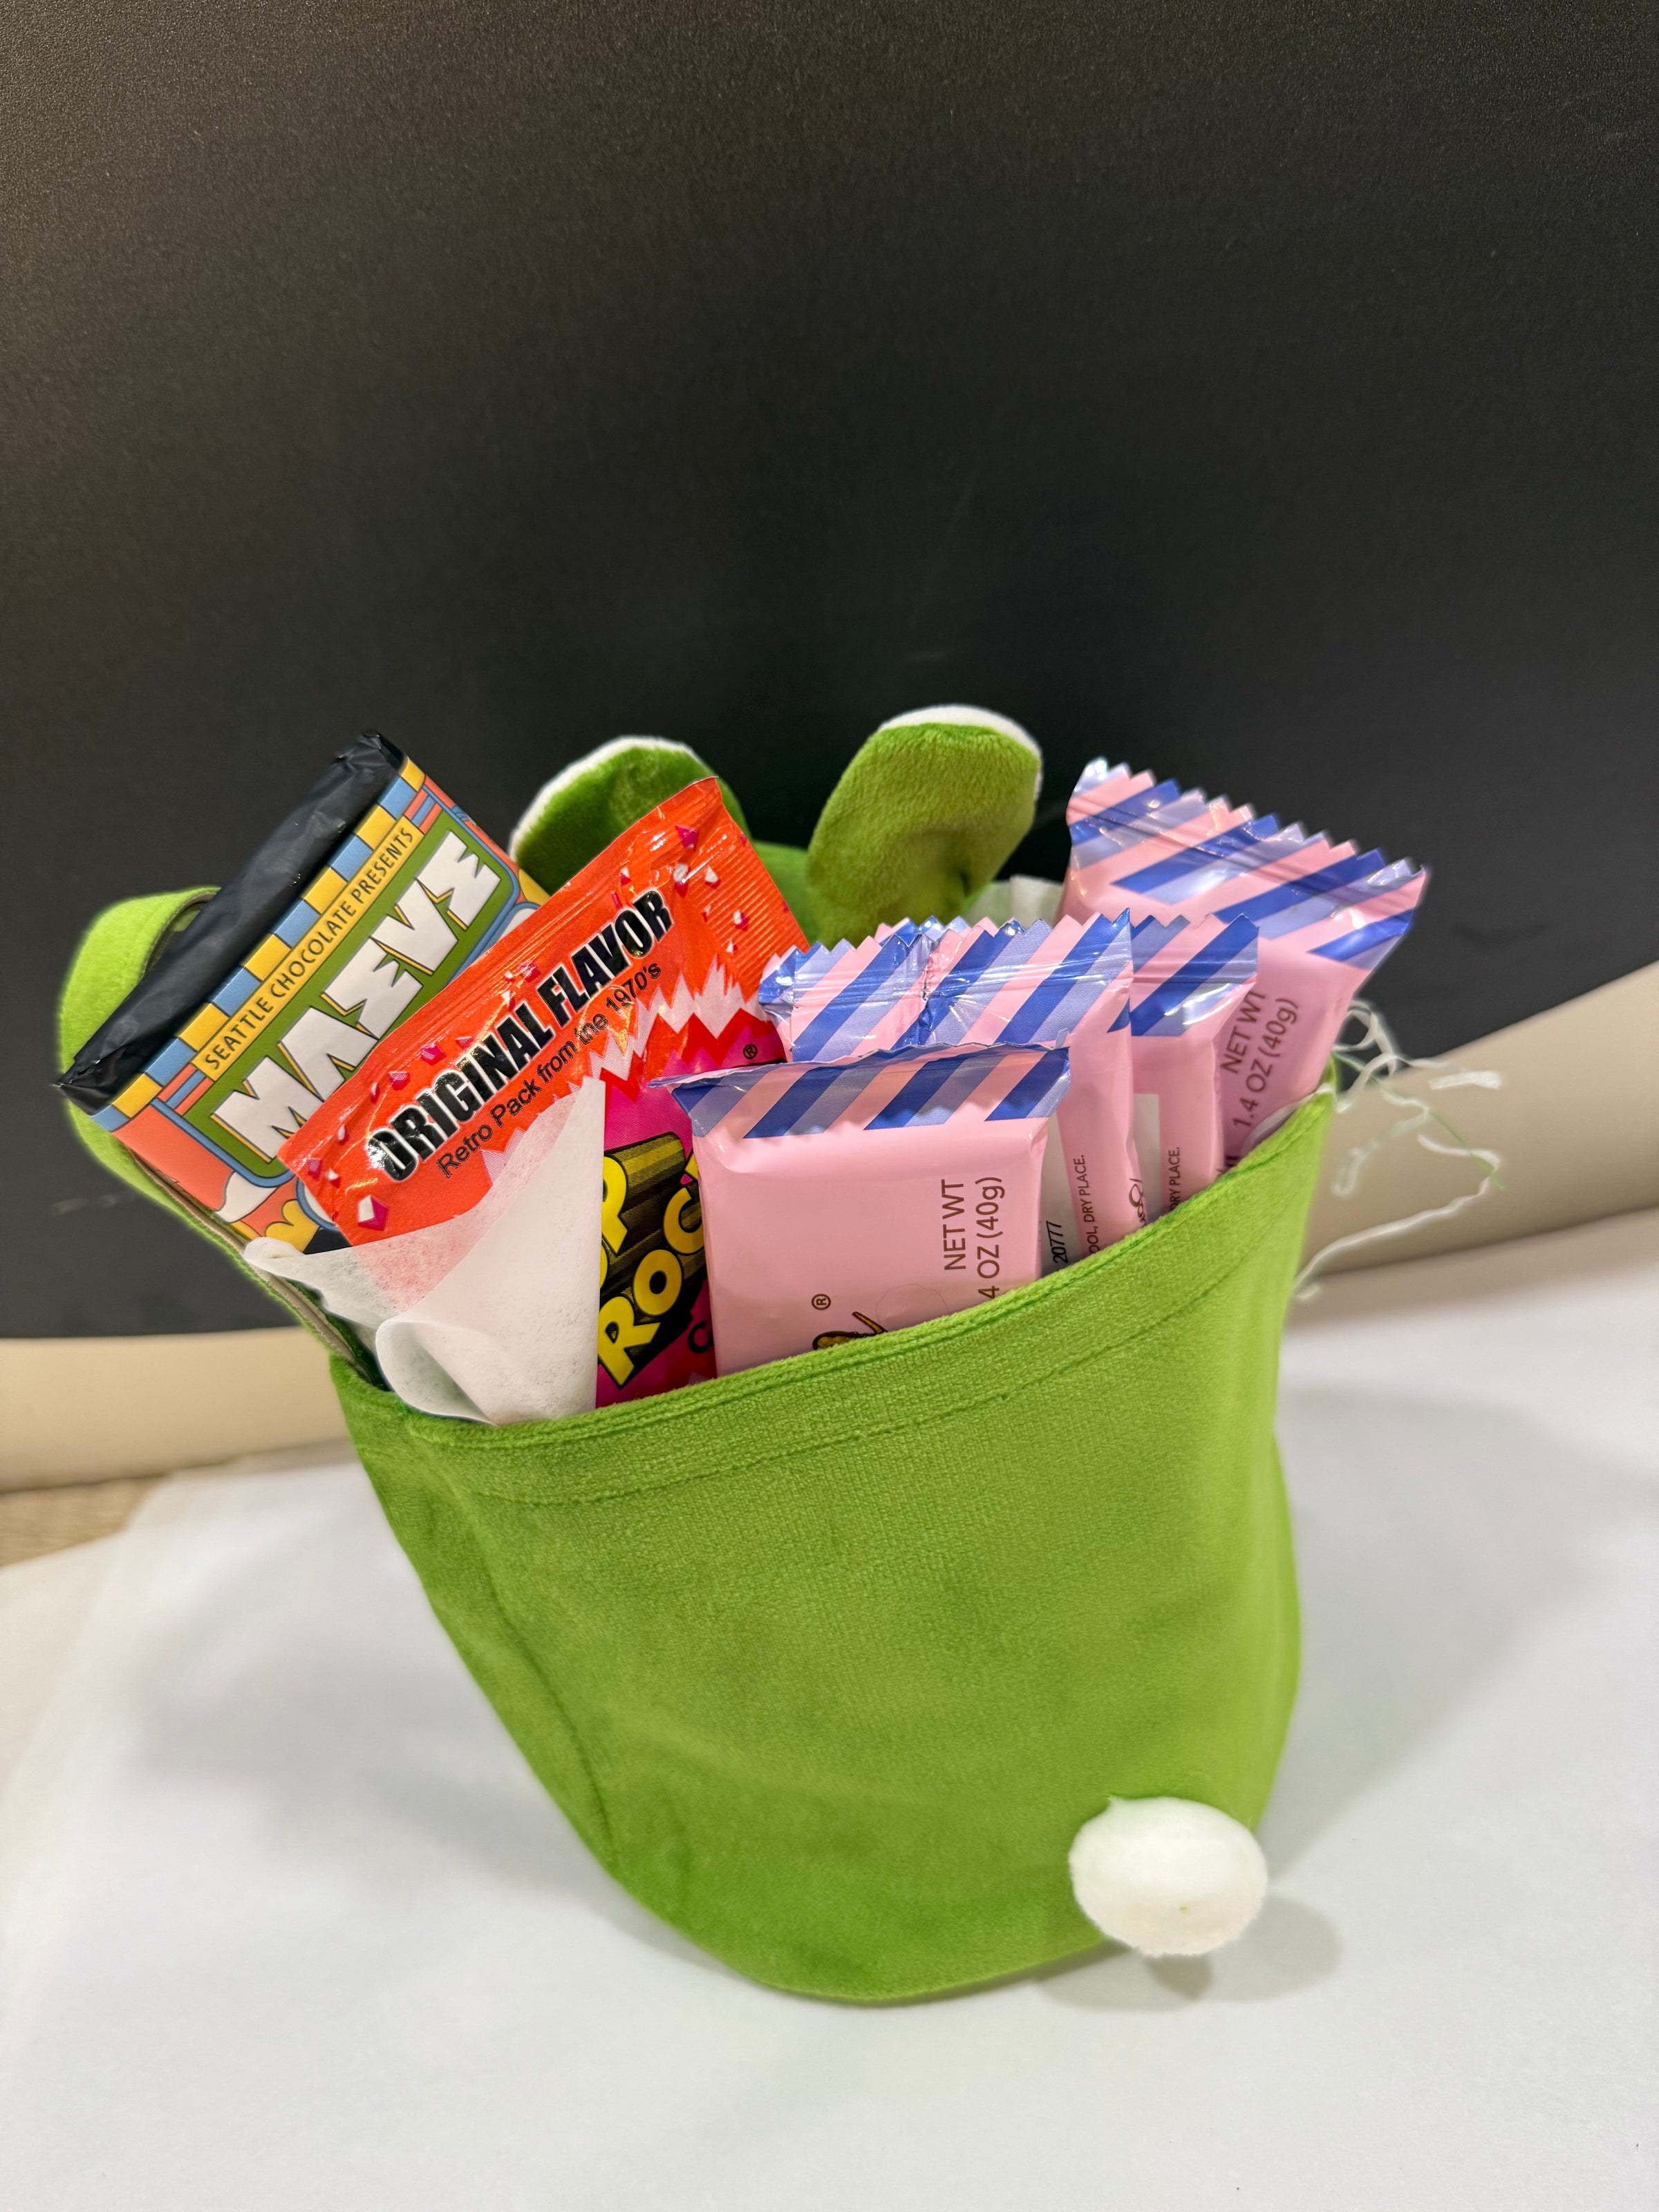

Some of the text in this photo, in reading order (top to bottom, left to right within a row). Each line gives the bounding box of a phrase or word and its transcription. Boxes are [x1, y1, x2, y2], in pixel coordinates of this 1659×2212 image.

[205, 827, 413, 1070] SEATTLE CHOCOLATE PRESENTS
[210, 830, 500, 1163] MAEVE
[366, 890, 674, 1181] ORIGINAL FLAVOR
[436, 962, 662, 1178] Retro Pack from the 1970's
[1220, 991, 1266, 1074] NET WT
[1232, 998, 1298, 1128] 1.4 OZ (40g)
[941, 1179, 966, 1271] NET WT
[1073, 1154, 1100, 1253] OOL, DRY PLACE.
[1168, 1147, 1180, 1185] PLACE.
[597, 1153, 704, 1387] ROC
[975, 1177, 1006, 1299] 4 OZ (40g)
[1046, 1220, 1068, 1264] 20777
